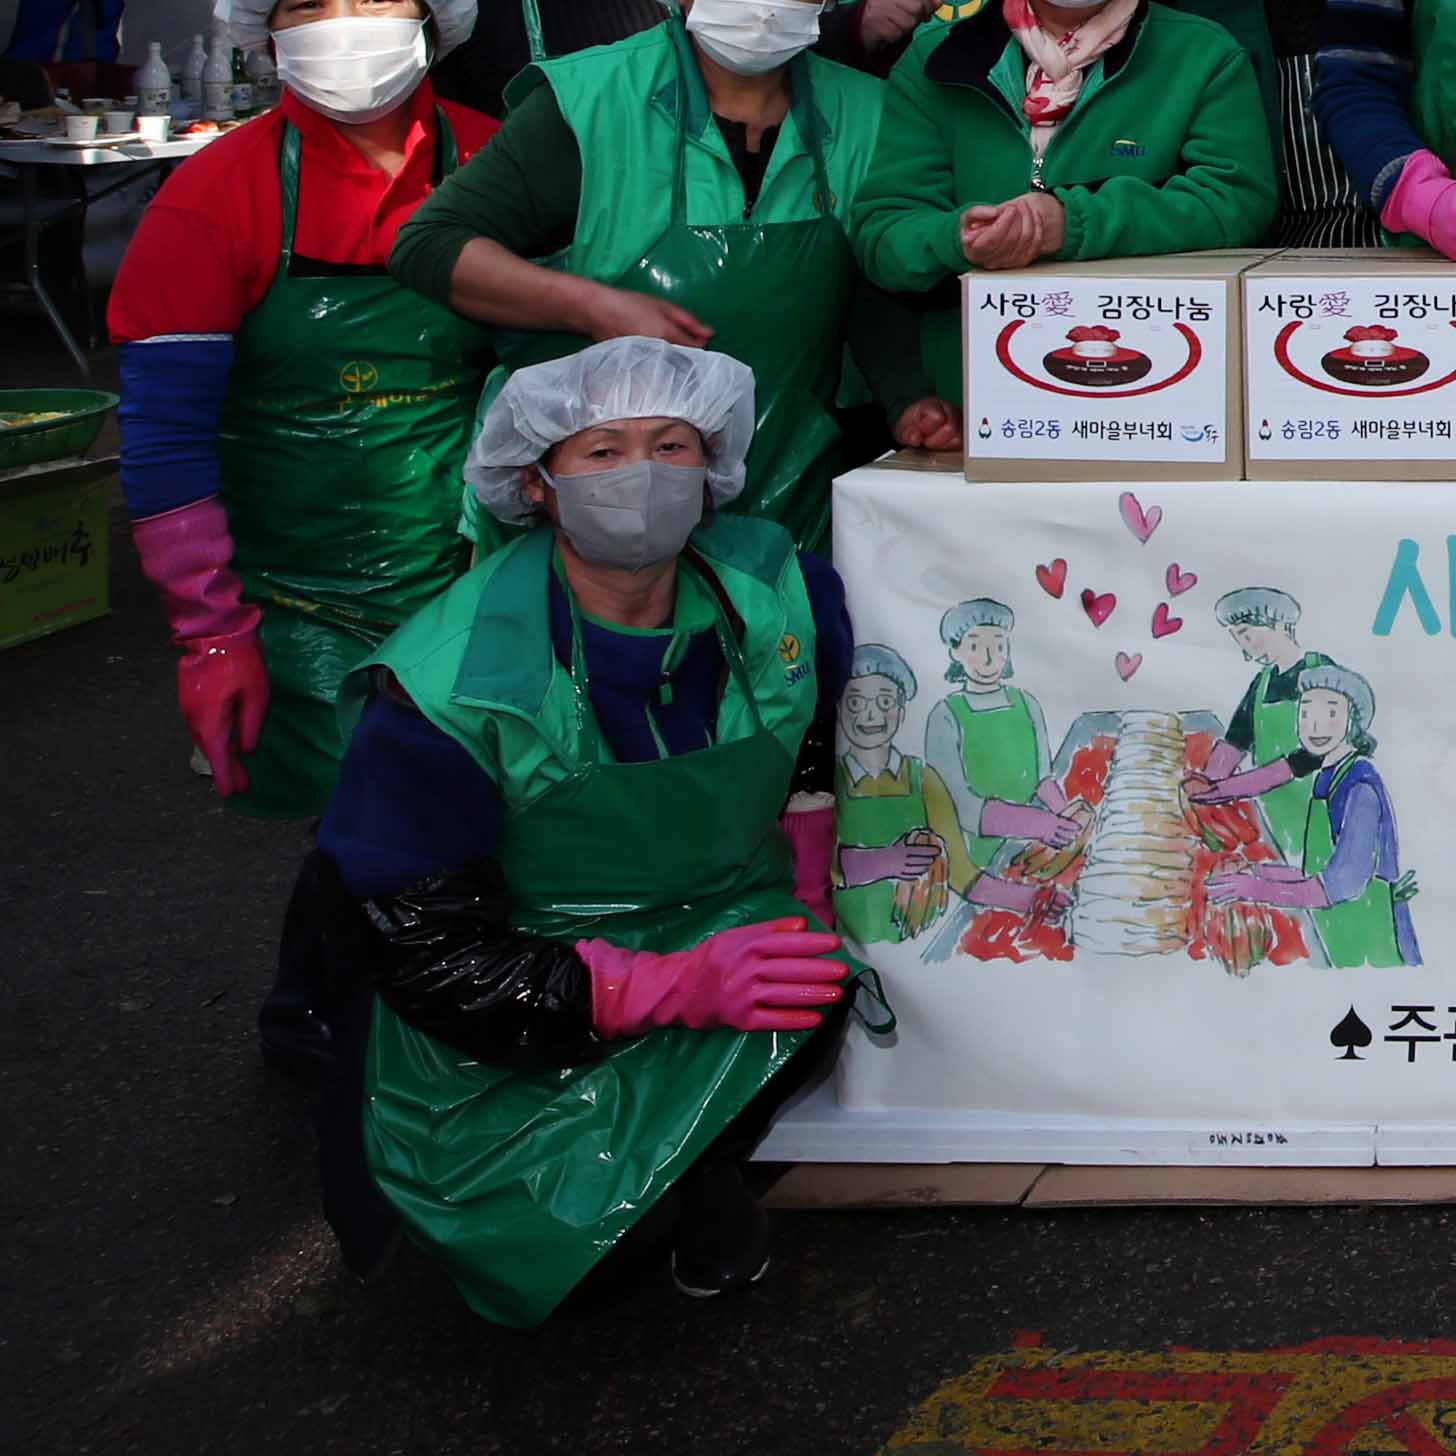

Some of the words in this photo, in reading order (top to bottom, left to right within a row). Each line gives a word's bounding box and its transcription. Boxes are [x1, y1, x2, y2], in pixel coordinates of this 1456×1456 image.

[980, 291, 1074, 318] 사랑愛
[1098, 295, 1213, 321] 김장나눔
[1258, 291, 1352, 319] 사랑愛
[1001, 419, 1061, 439] 송림2동
[1072, 420, 1172, 440] 새마을부녀회
[1281, 420, 1341, 440] 송림2동
[1352, 420, 1451, 440] 새마을부녀회
